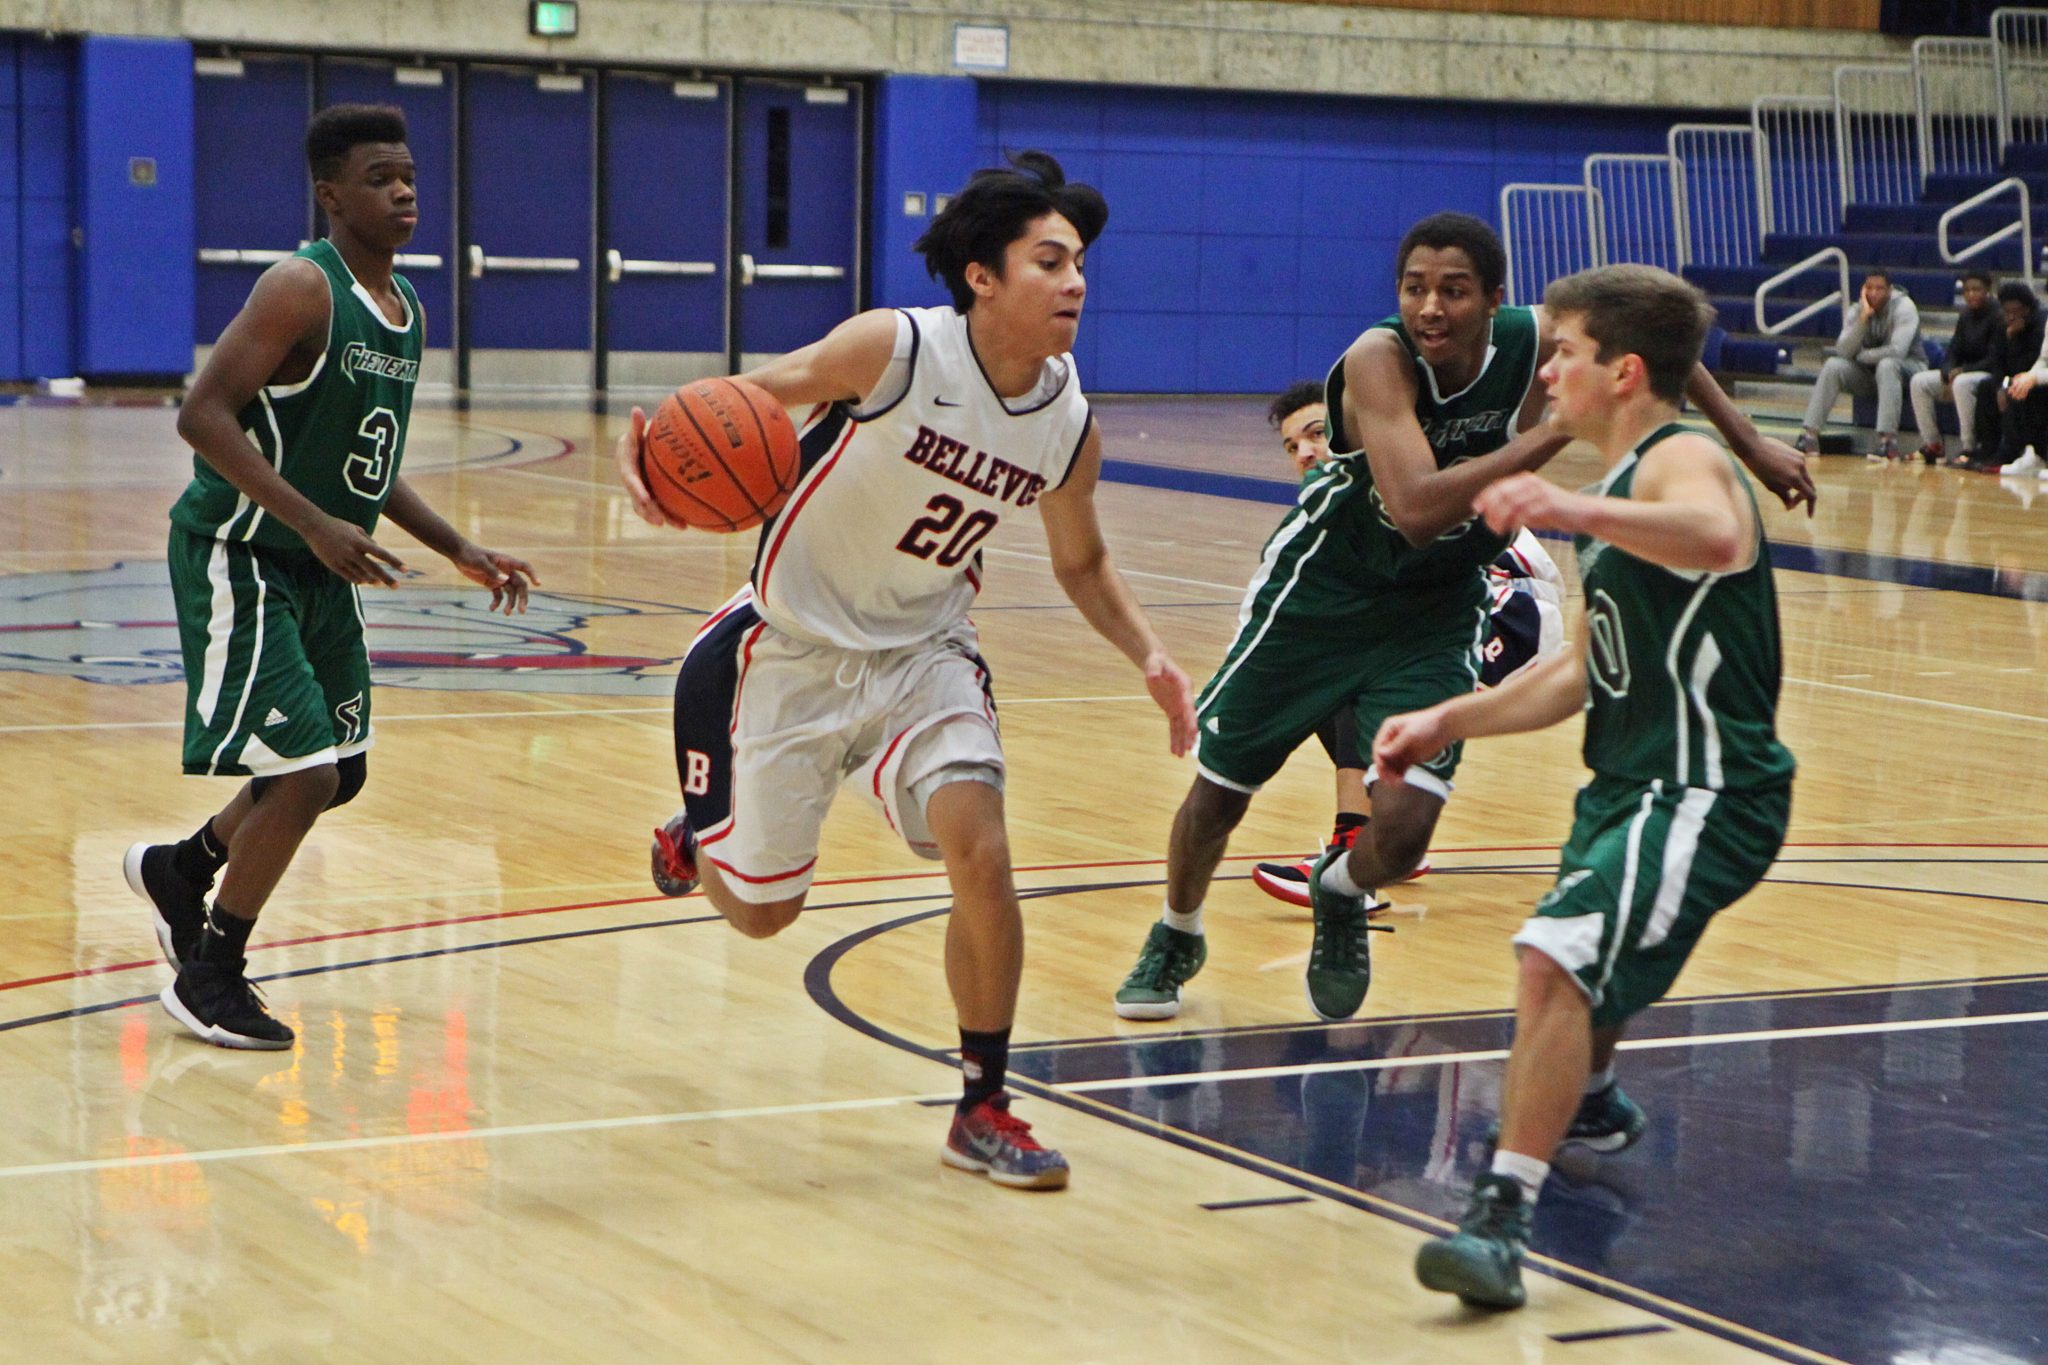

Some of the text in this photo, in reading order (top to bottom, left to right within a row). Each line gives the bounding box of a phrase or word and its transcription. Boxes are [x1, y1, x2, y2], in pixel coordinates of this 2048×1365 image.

[343, 406, 399, 501] 3
[896, 494, 999, 567] 20
[684, 748, 711, 797] B
